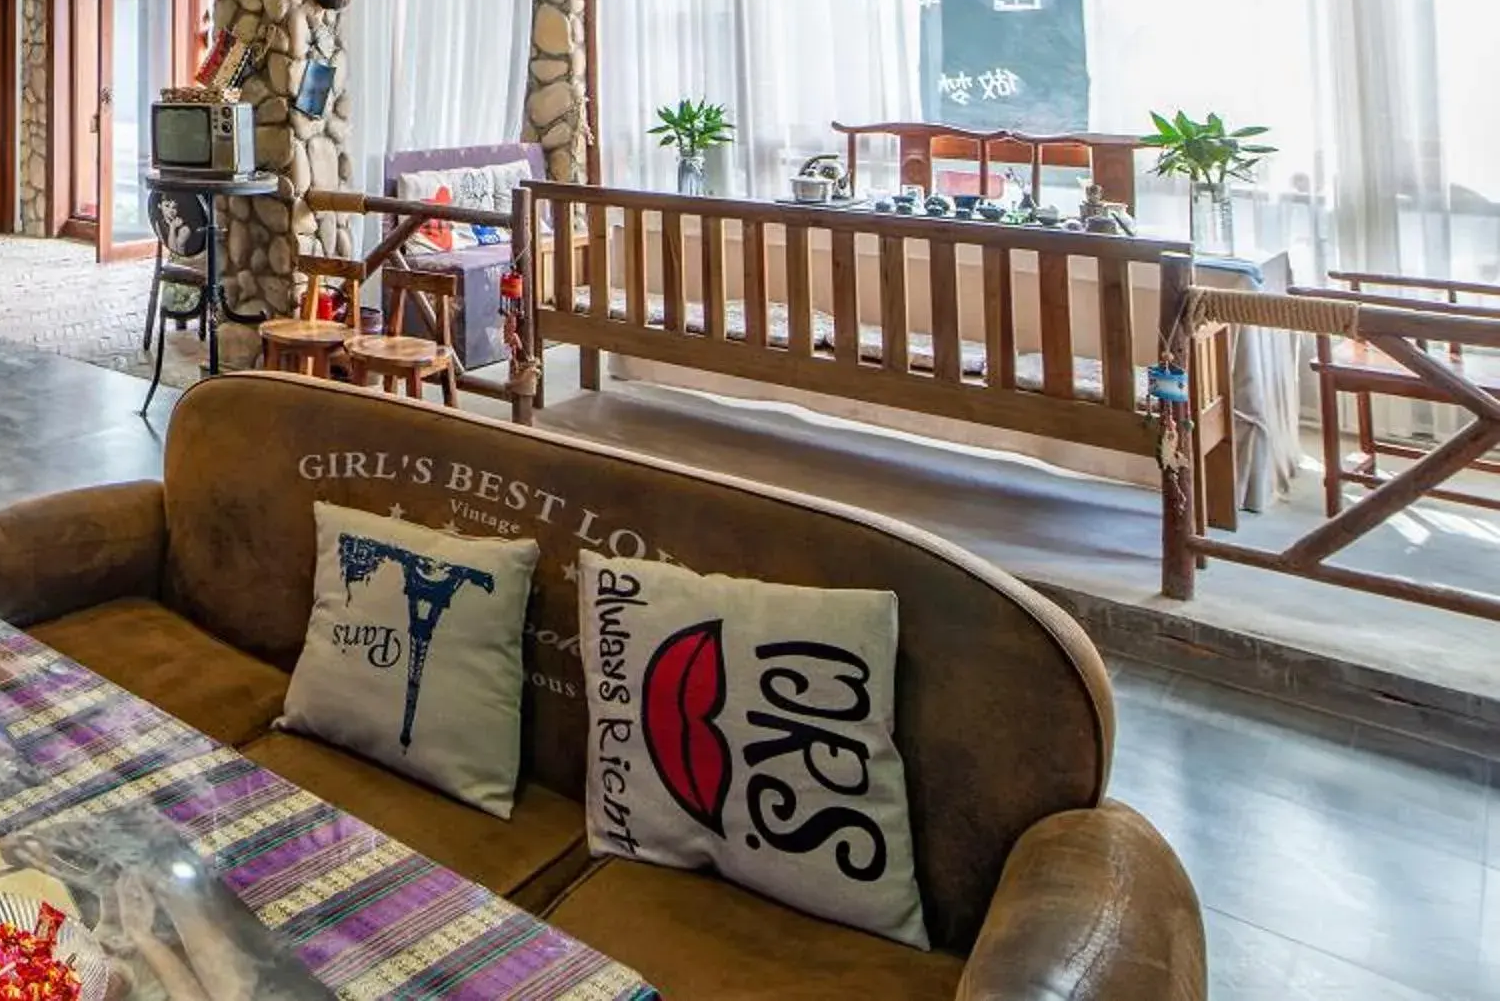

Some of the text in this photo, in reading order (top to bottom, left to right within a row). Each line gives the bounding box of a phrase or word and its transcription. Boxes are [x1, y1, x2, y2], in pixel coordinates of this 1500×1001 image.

[299, 452, 690, 569] GIRL'S BEST LO
[450, 498, 522, 535] Vintage
[332, 623, 402, 668] Paris
